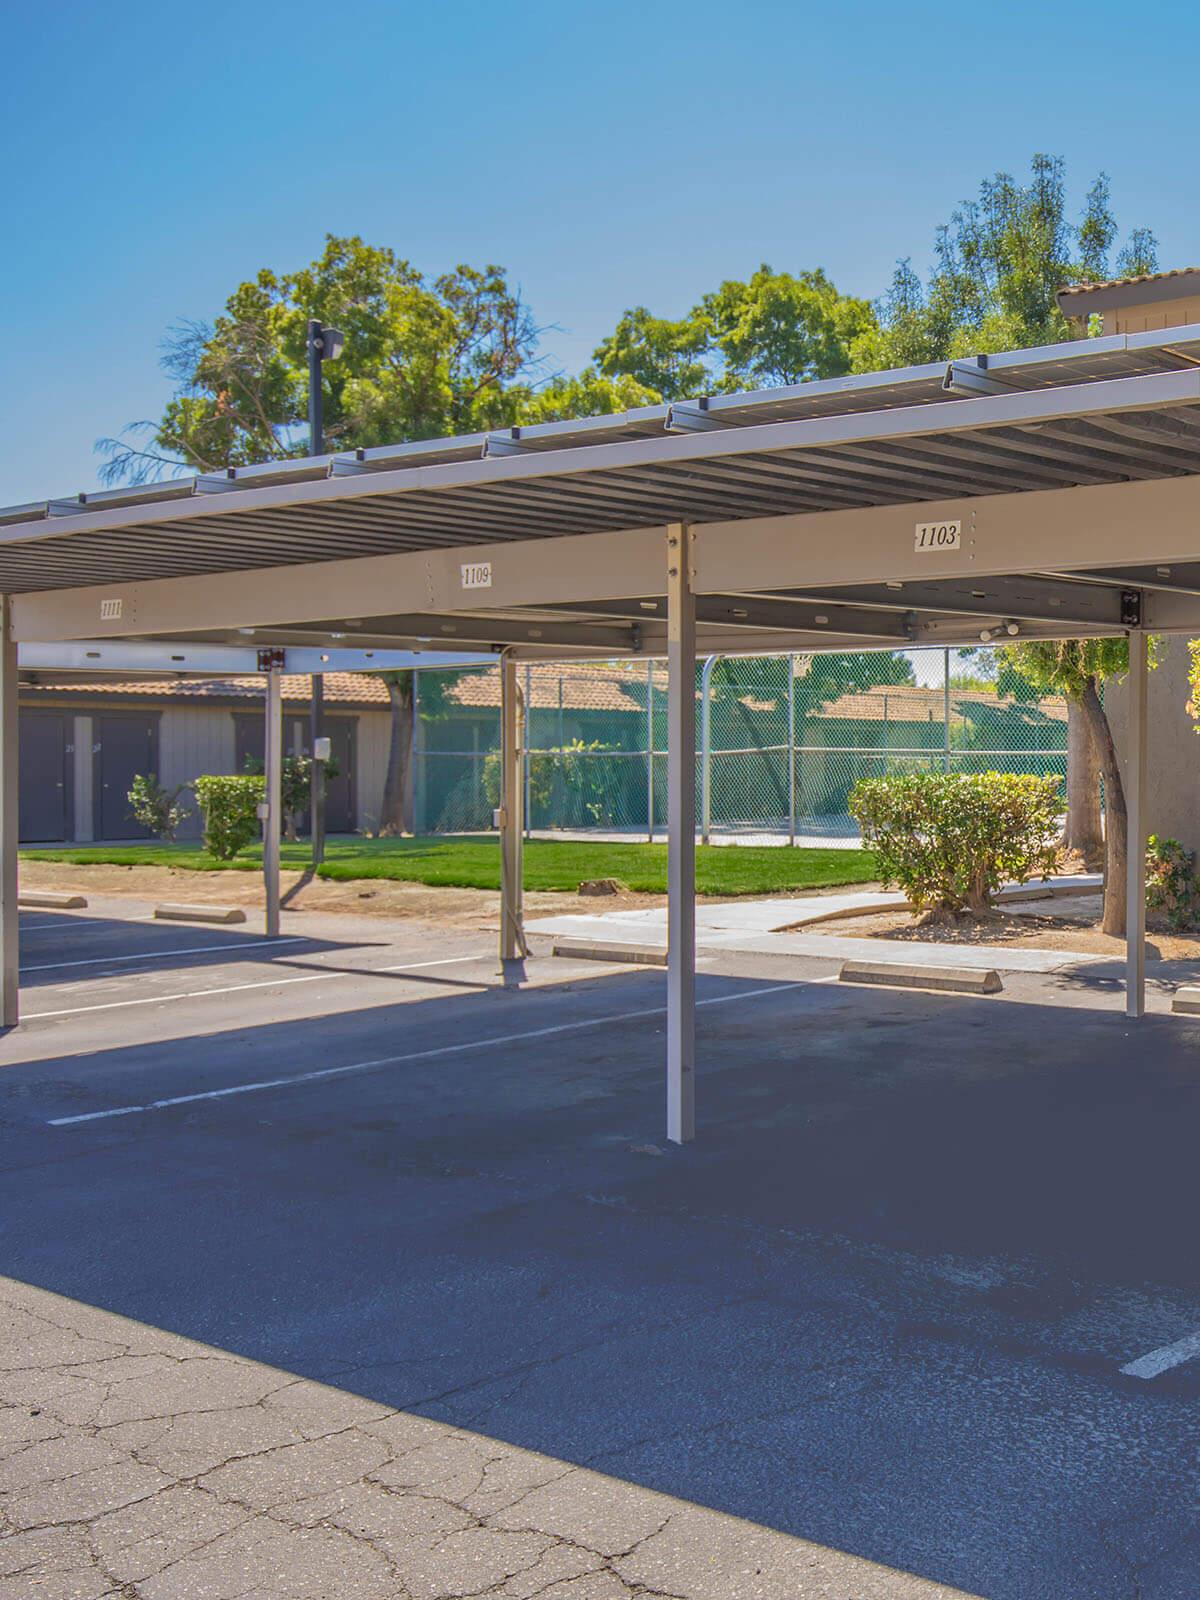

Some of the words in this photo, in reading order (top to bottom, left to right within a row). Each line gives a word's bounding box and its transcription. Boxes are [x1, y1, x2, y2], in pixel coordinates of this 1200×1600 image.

[919, 525, 957, 547] 1103
[465, 567, 489, 584] 1109
[103, 601, 120, 617] 1111
